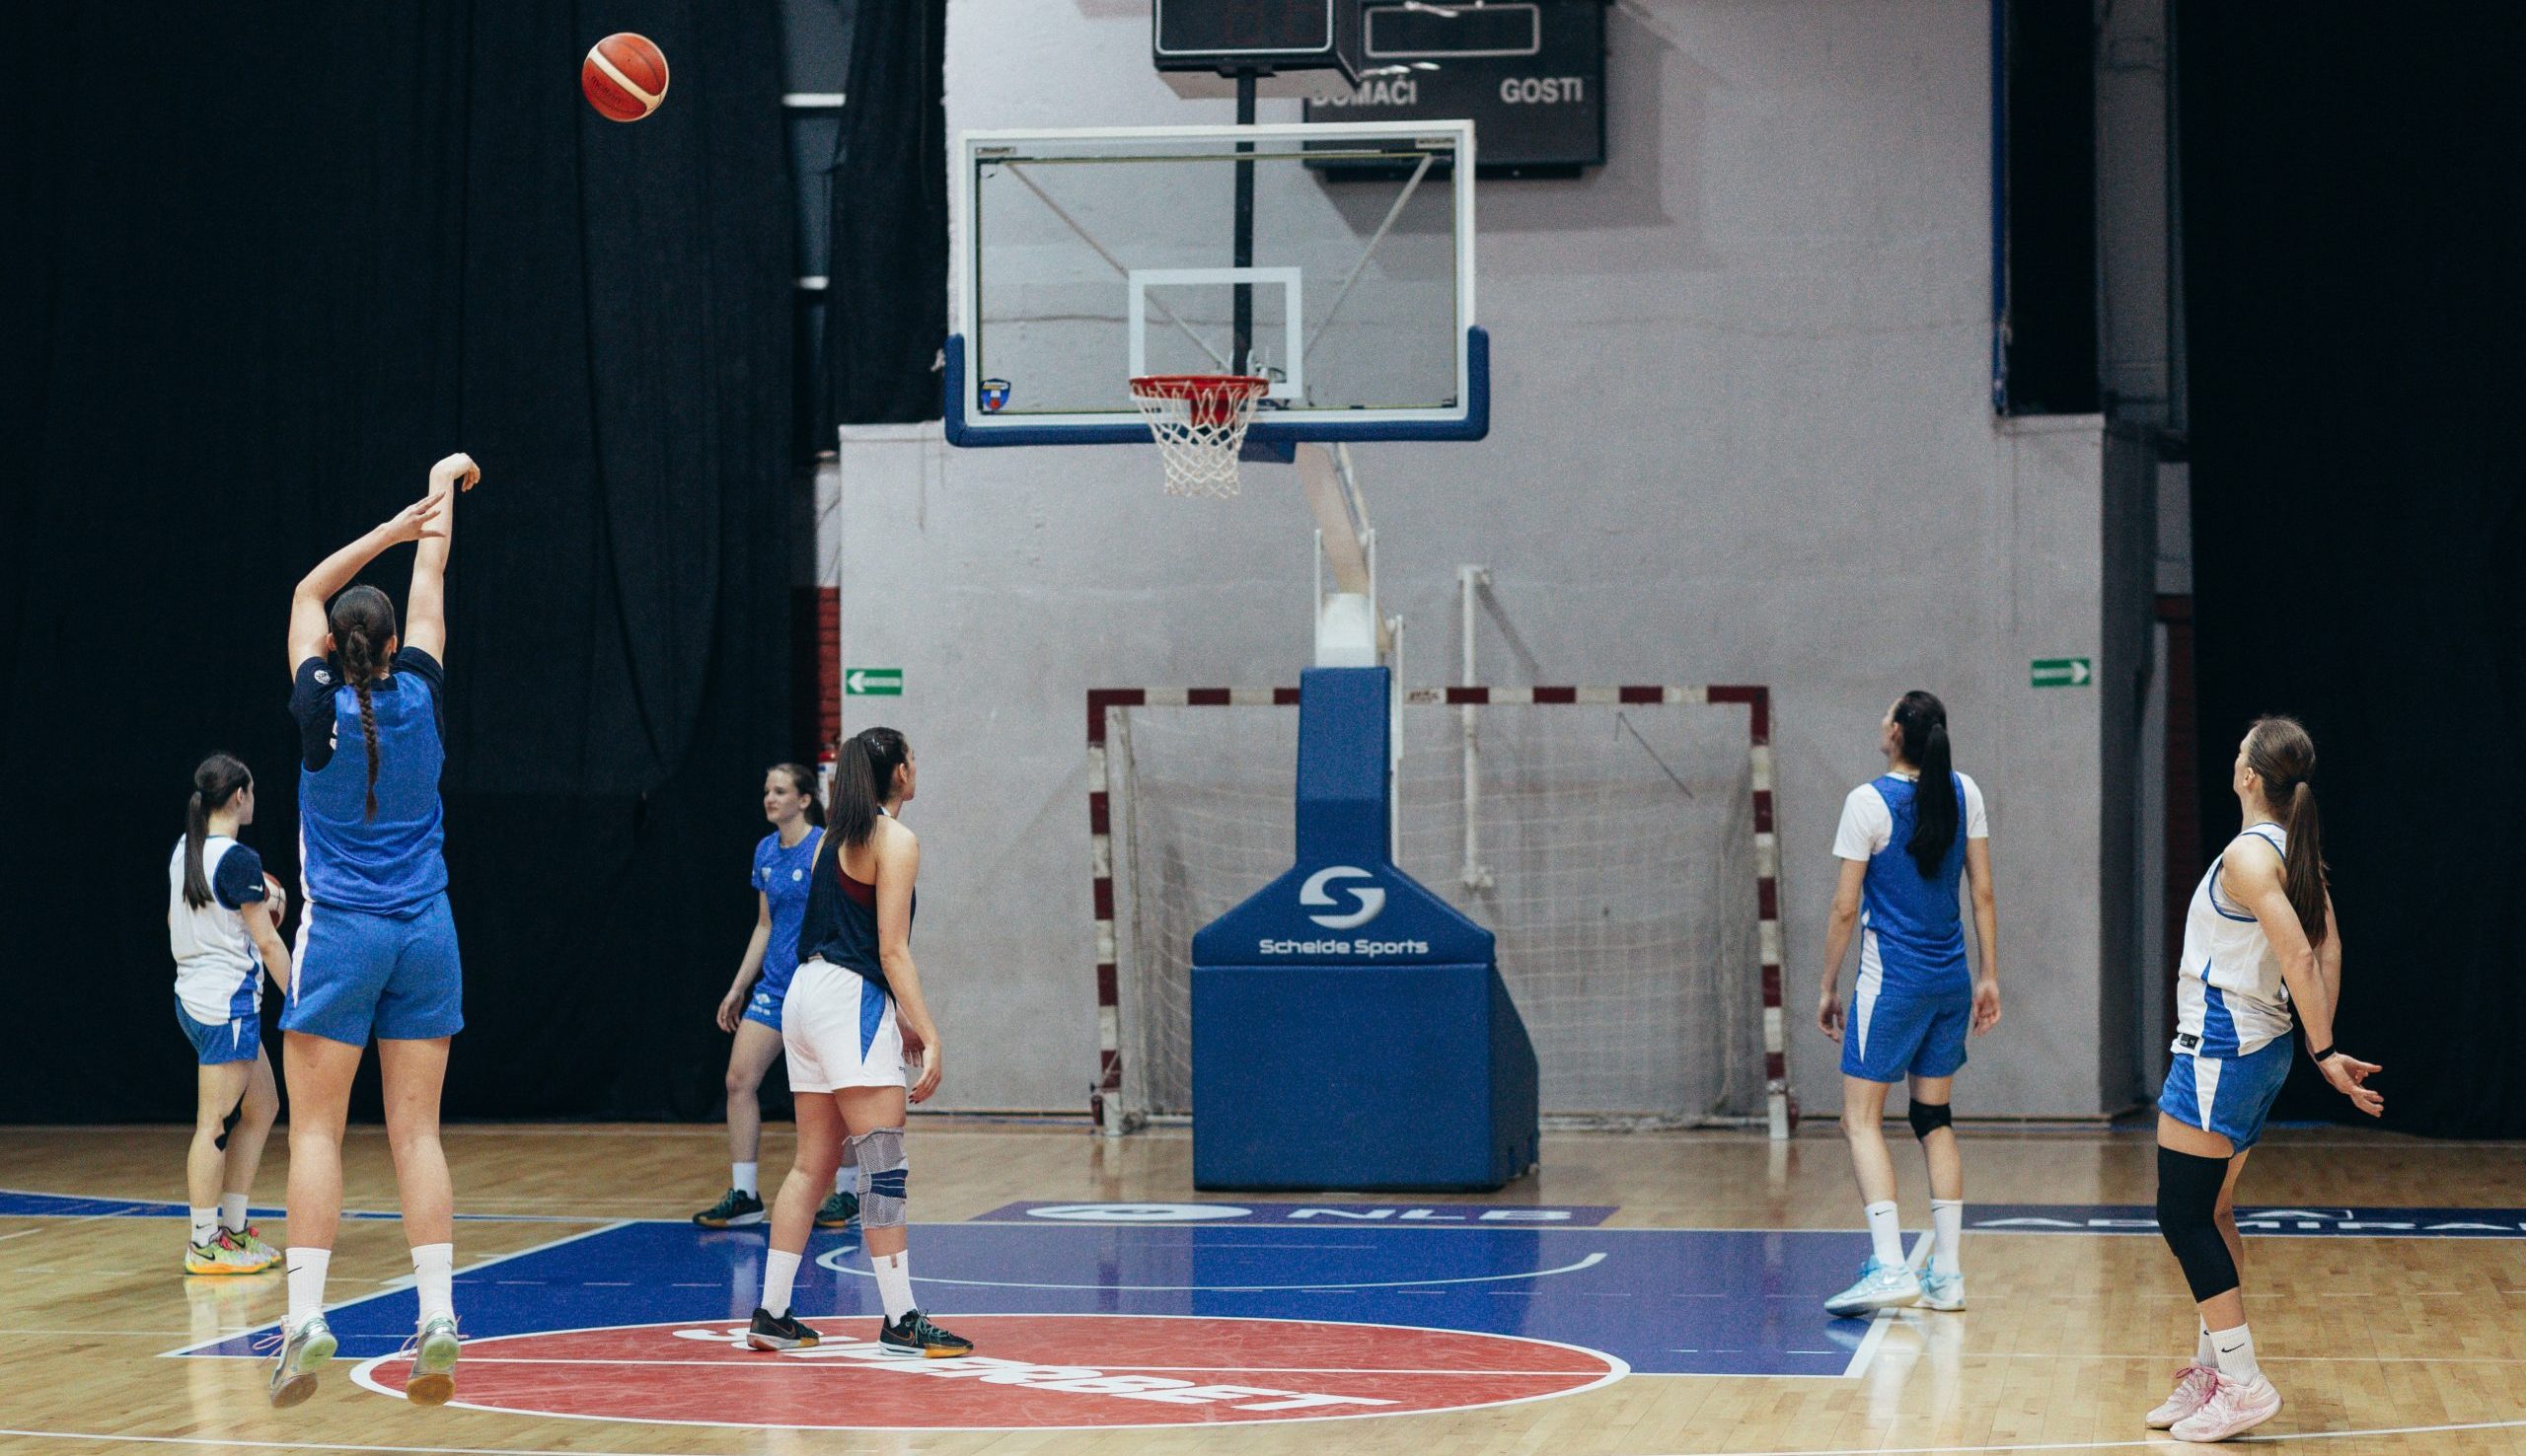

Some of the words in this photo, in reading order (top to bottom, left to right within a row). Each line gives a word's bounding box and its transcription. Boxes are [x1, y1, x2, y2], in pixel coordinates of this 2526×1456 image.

[1500, 77, 1583, 104] GOSTI
[1259, 938, 1351, 955] Schelde
[1355, 938, 1430, 959] Sports
[1287, 1208, 1573, 1221] NLB
[1970, 1217, 2526, 1230] ADIRA
